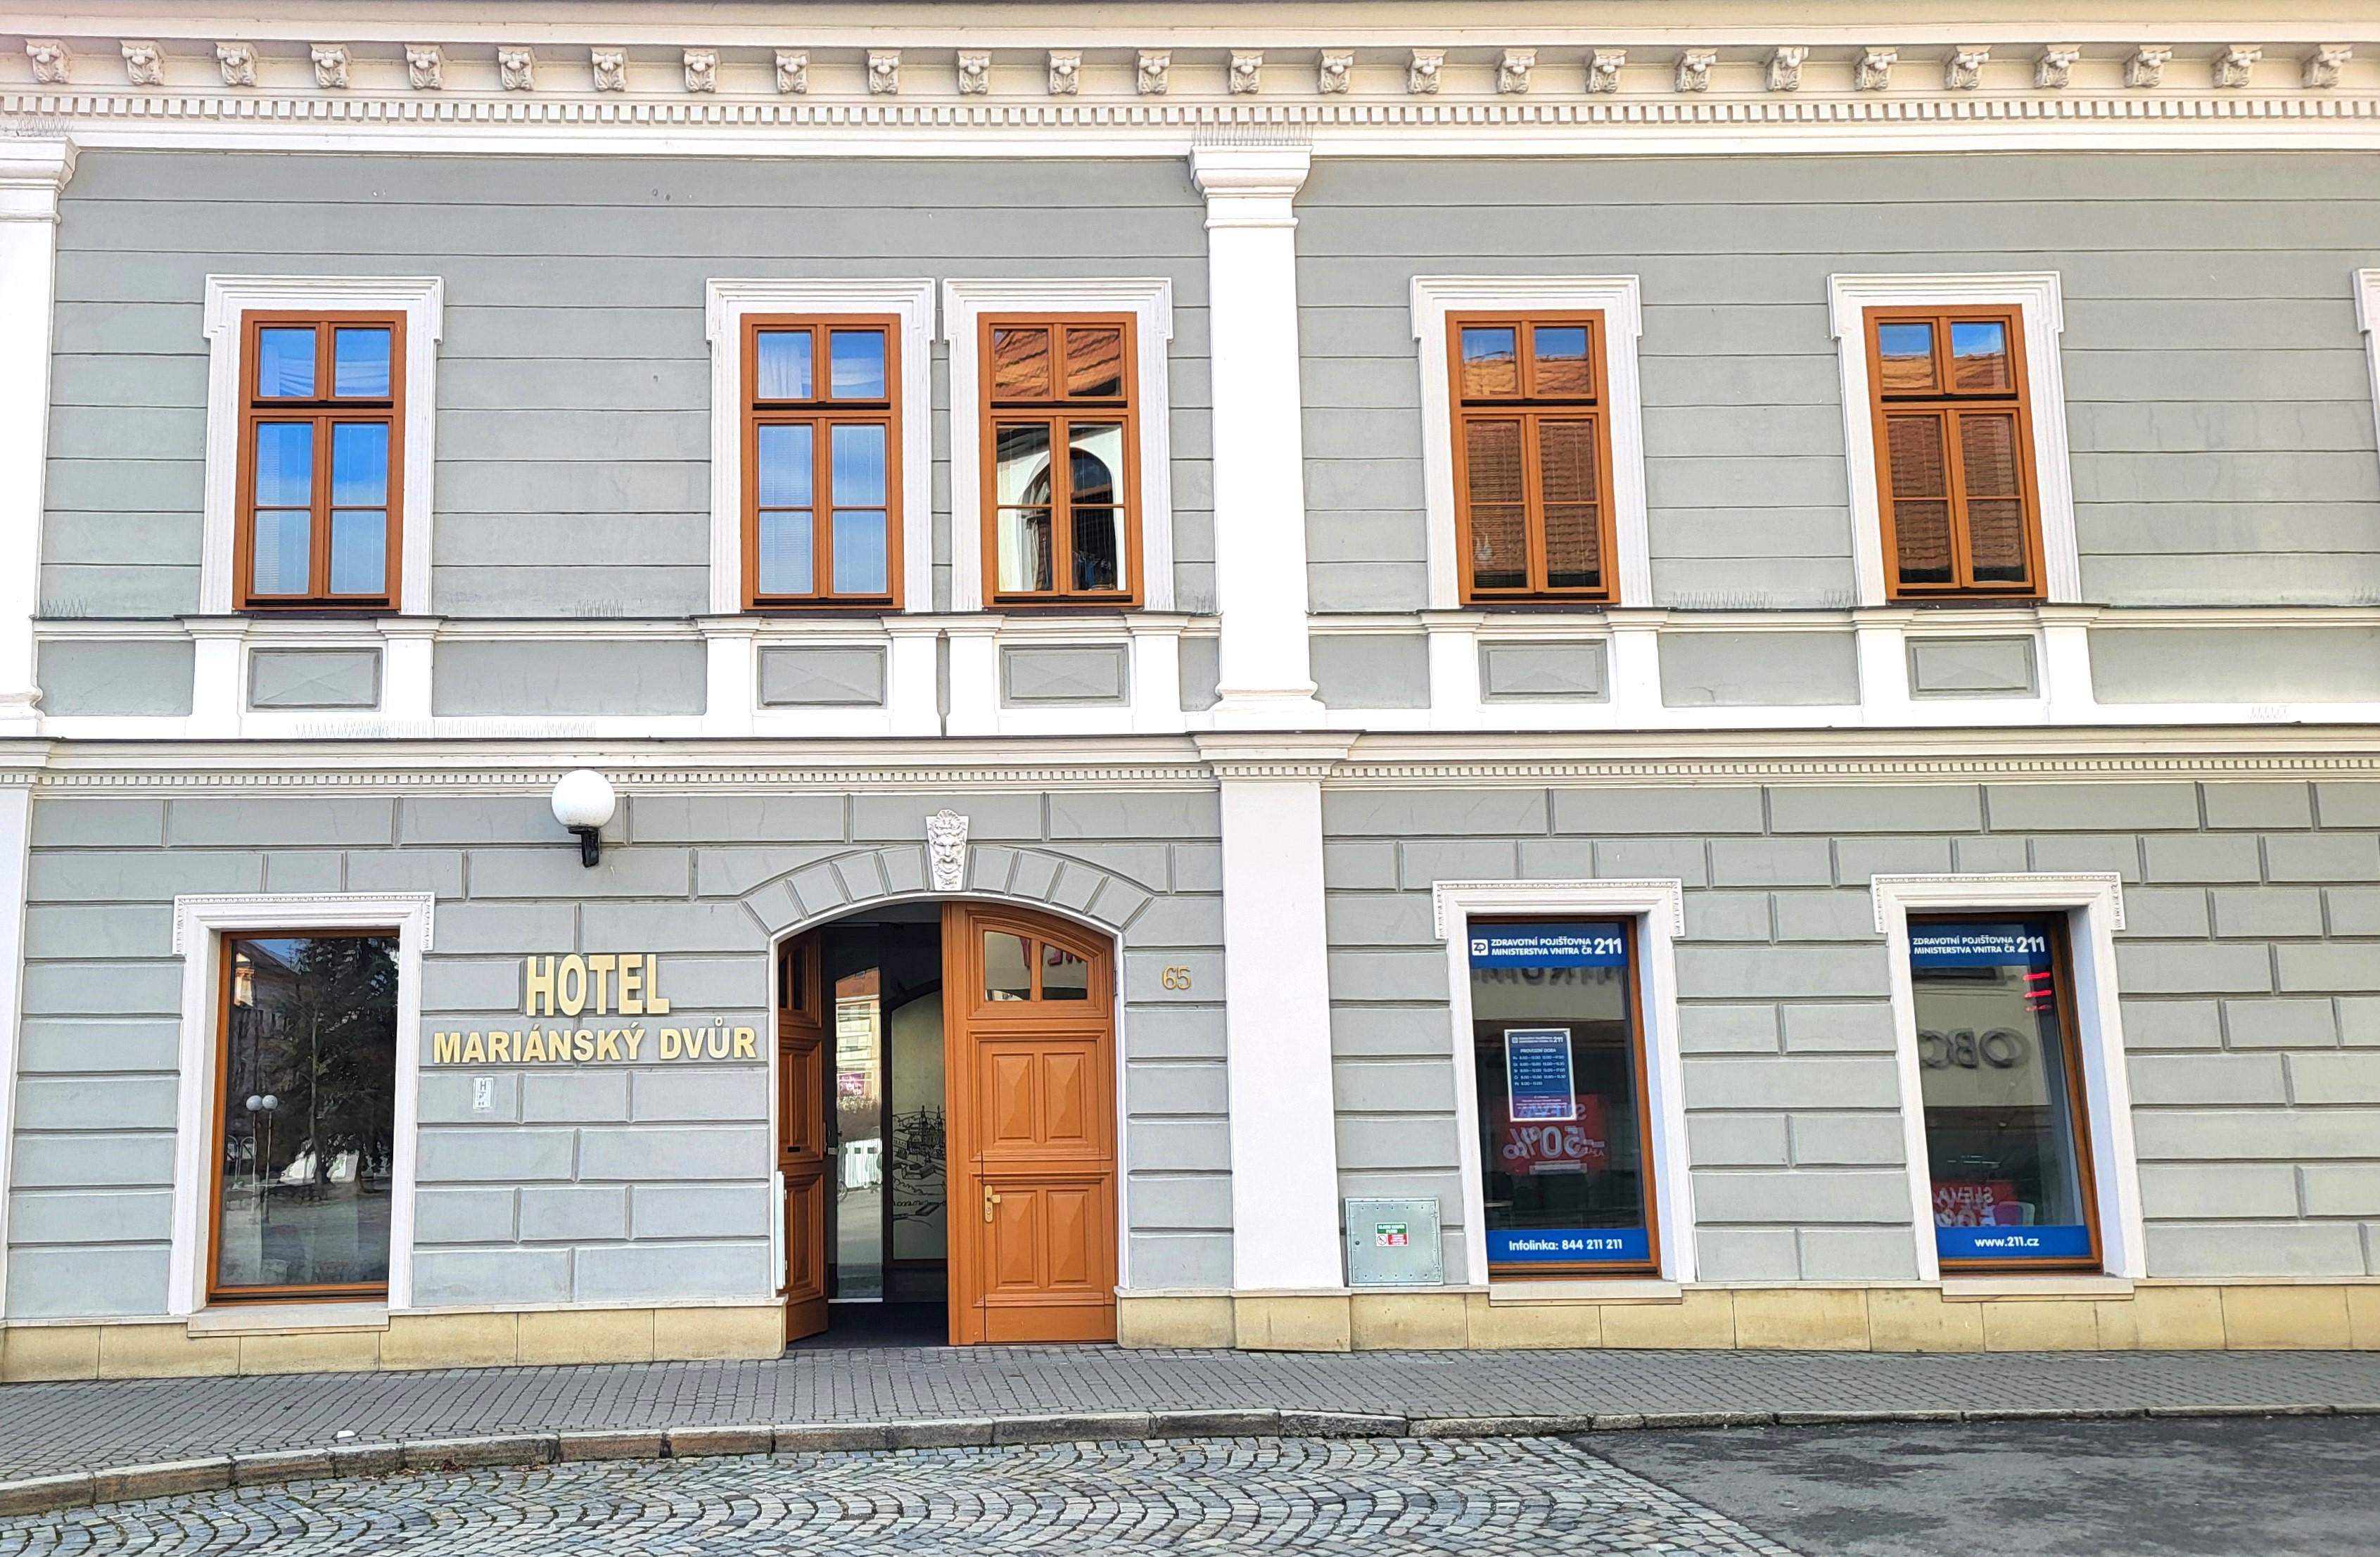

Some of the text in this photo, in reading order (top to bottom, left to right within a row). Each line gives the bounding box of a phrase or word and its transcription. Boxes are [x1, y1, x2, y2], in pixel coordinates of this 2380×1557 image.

[1491, 936, 1591, 946] ZDRAVOTNÍ POJIŠŤOVNA
[1913, 934, 2013, 945] ZDRAVOTNÍ POJIŠŤOVNA
[2016, 936, 2045, 953] 211
[1582, 945, 1592, 955] ČR
[1594, 938, 1622, 954] 211
[2004, 943, 2015, 953] ČR
[1162, 967, 1191, 990] 65
[526, 953, 670, 1017] HOTEL
[433, 1017, 757, 1064] MARIÁNSKÝ DVŮR
[1509, 1239, 1622, 1250] Infolinka: 844 211 211
[1974, 1236, 2039, 1247] www.211.cz
